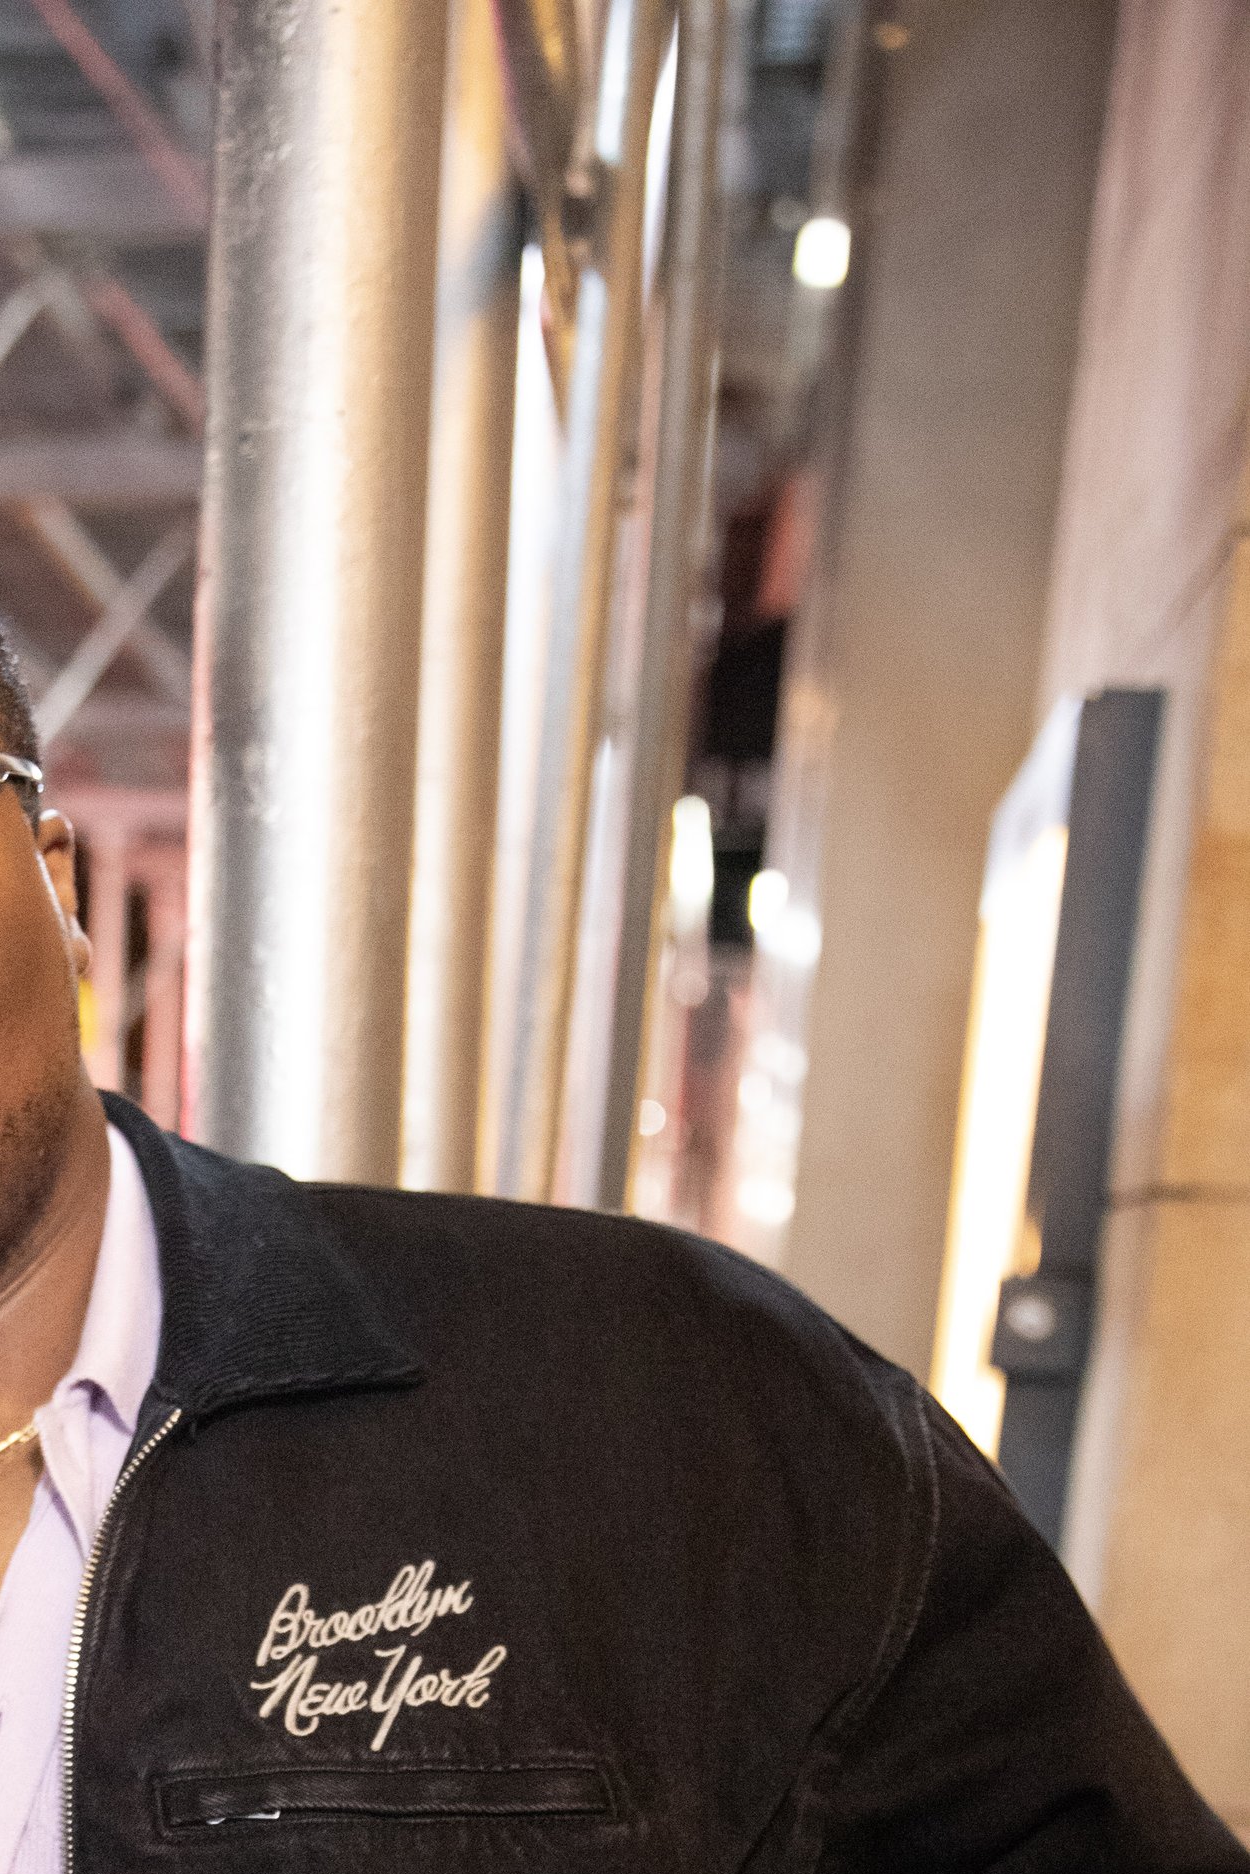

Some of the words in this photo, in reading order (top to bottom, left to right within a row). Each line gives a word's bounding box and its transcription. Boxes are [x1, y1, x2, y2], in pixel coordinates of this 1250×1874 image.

[256, 1559, 474, 1667] Brooklyn
[251, 1653, 368, 1737] New
[370, 1644, 508, 1752] York
